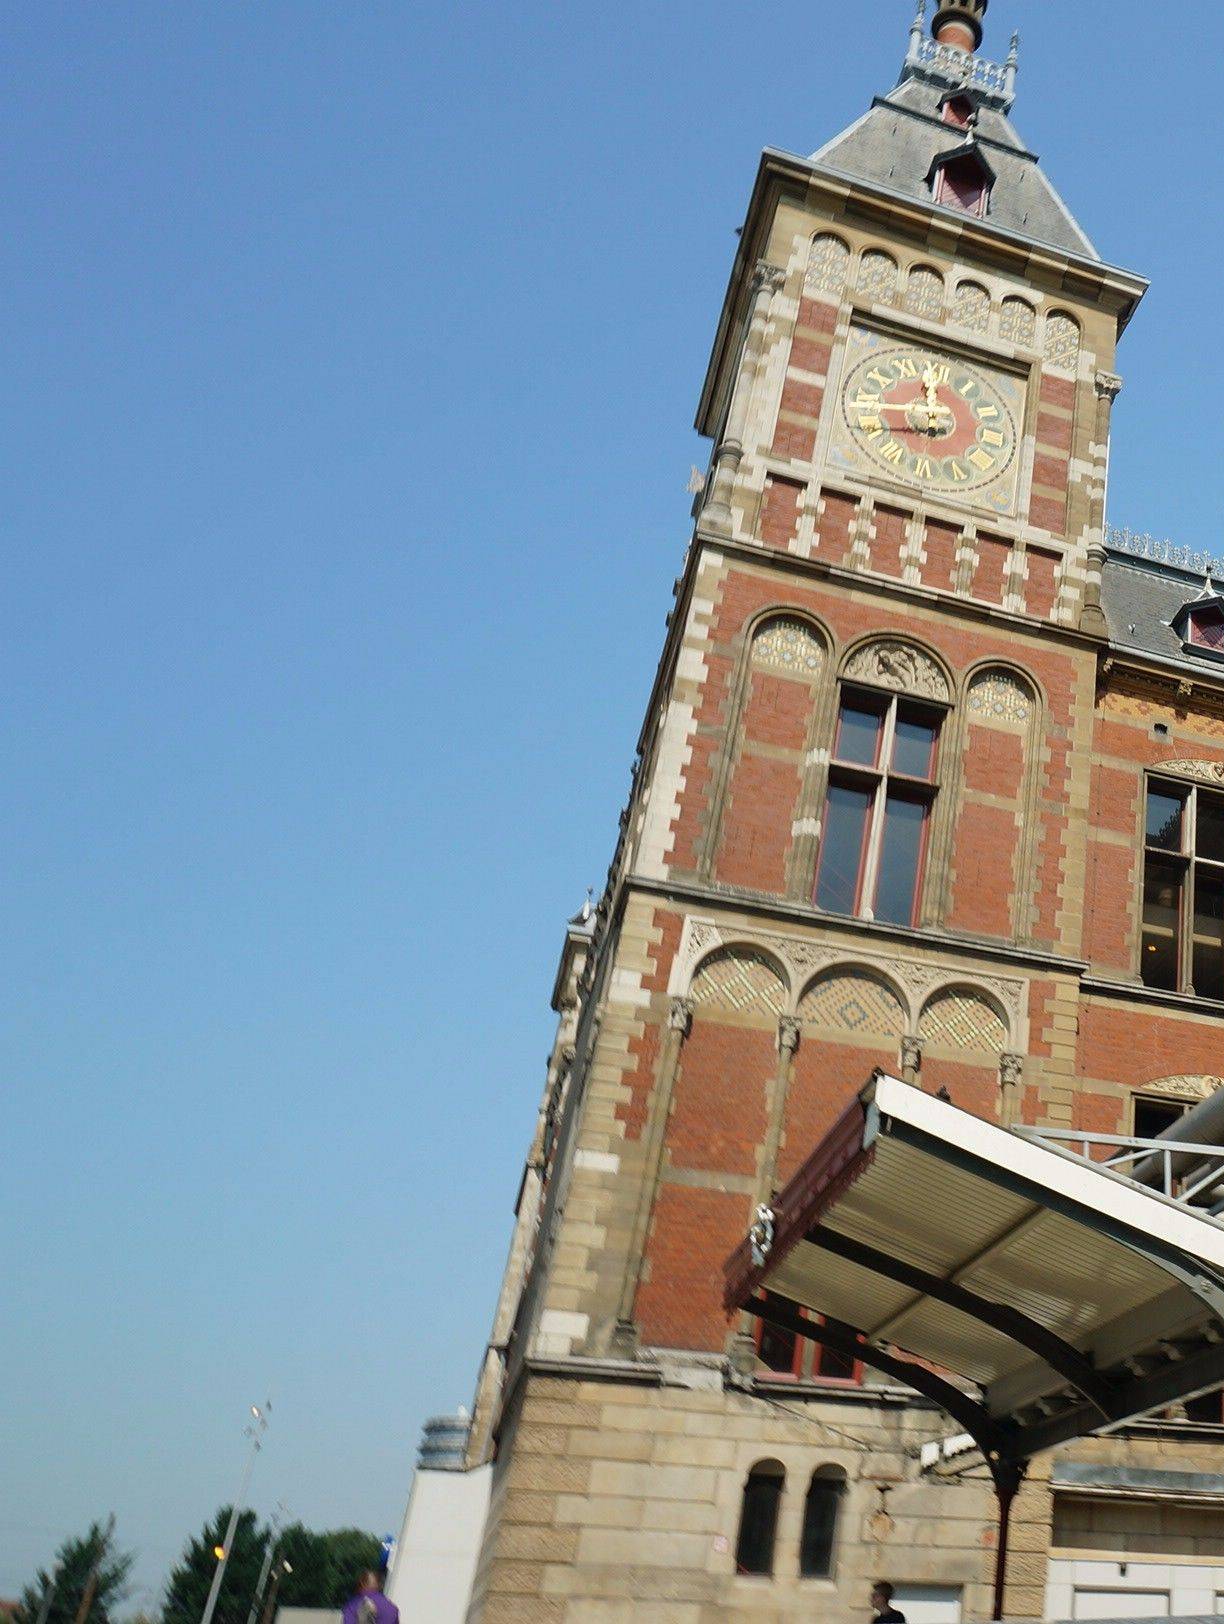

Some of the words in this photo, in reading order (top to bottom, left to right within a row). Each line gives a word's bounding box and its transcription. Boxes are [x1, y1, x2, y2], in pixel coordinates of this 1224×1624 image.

[867, 367, 894, 390] X
[891, 359, 917, 379] XI
[959, 379, 975, 397] I
[976, 405, 998, 419] II
[981, 428, 1004, 448] III
[880, 438, 904, 464] VII
[913, 458, 933, 480] VI
[951, 461, 968, 480] V
